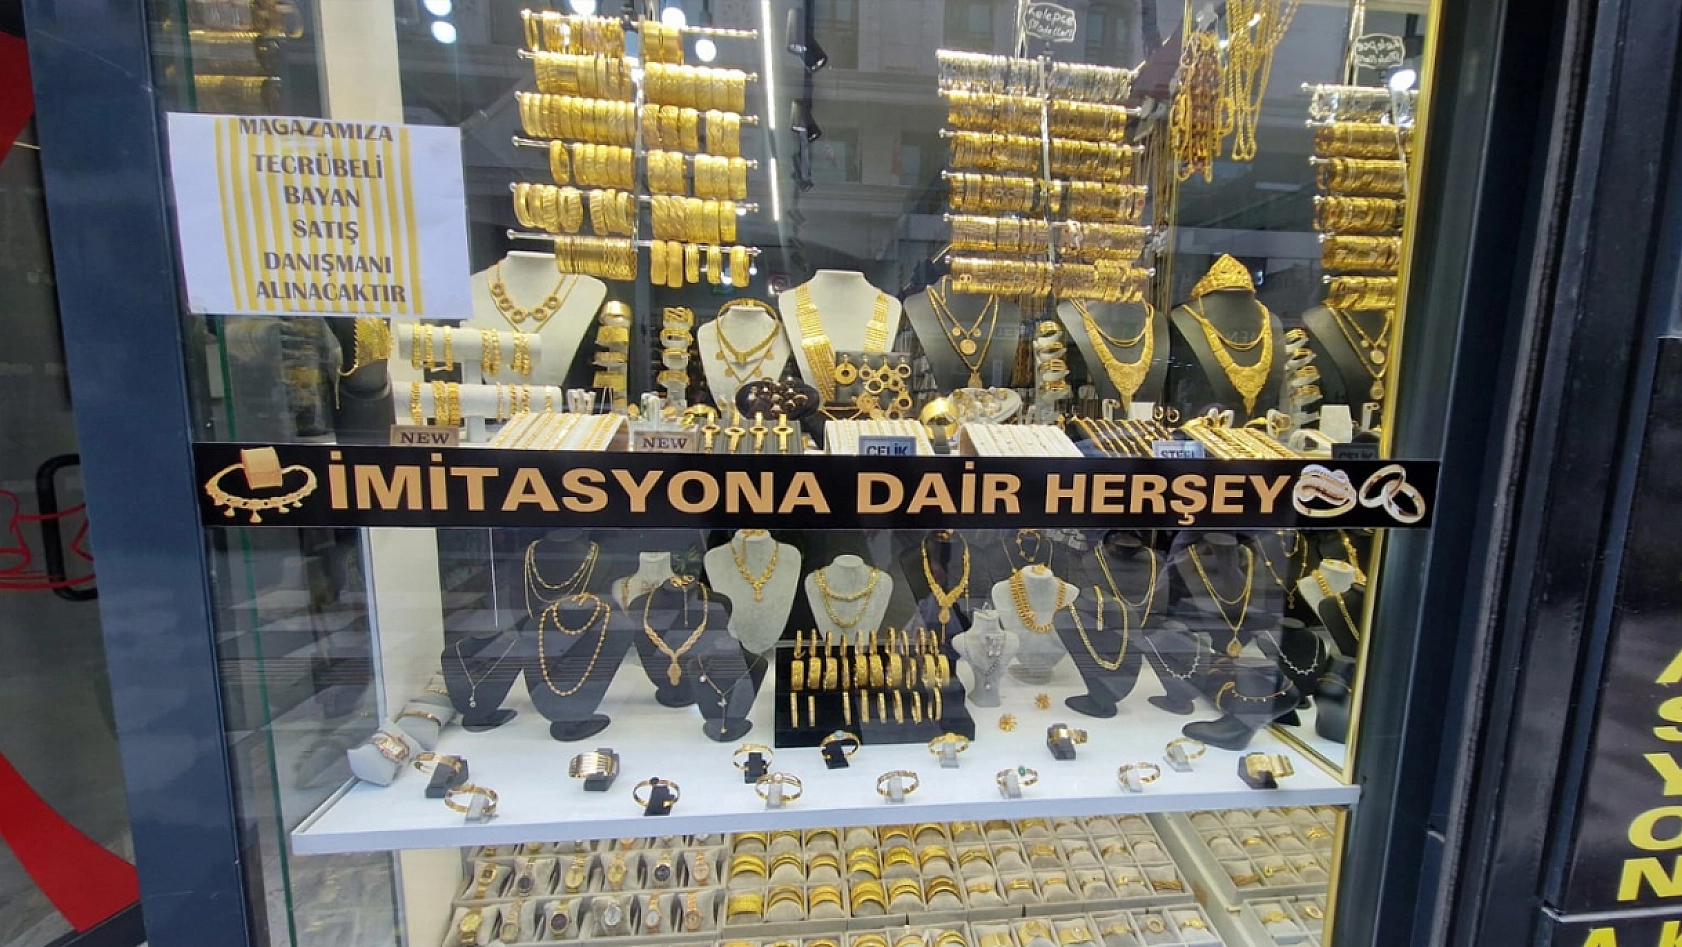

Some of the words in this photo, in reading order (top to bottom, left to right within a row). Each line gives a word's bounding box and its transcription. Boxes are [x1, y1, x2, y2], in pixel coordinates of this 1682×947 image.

[252, 153, 384, 179] TECRÜBELİ
[283, 185, 361, 208] BAYAN
[292, 219, 359, 245] SATIŞ
[263, 251, 392, 277] DANIŞMANI
[256, 281, 406, 303] ALINACAKTIR
[400, 432, 450, 445] NEW
[643, 437, 688, 450] NEW
[328, 450, 831, 514] İMİTASYONA
[856, 461, 1022, 515] DAİR
[1044, 472, 1291, 526] HERŞEY
